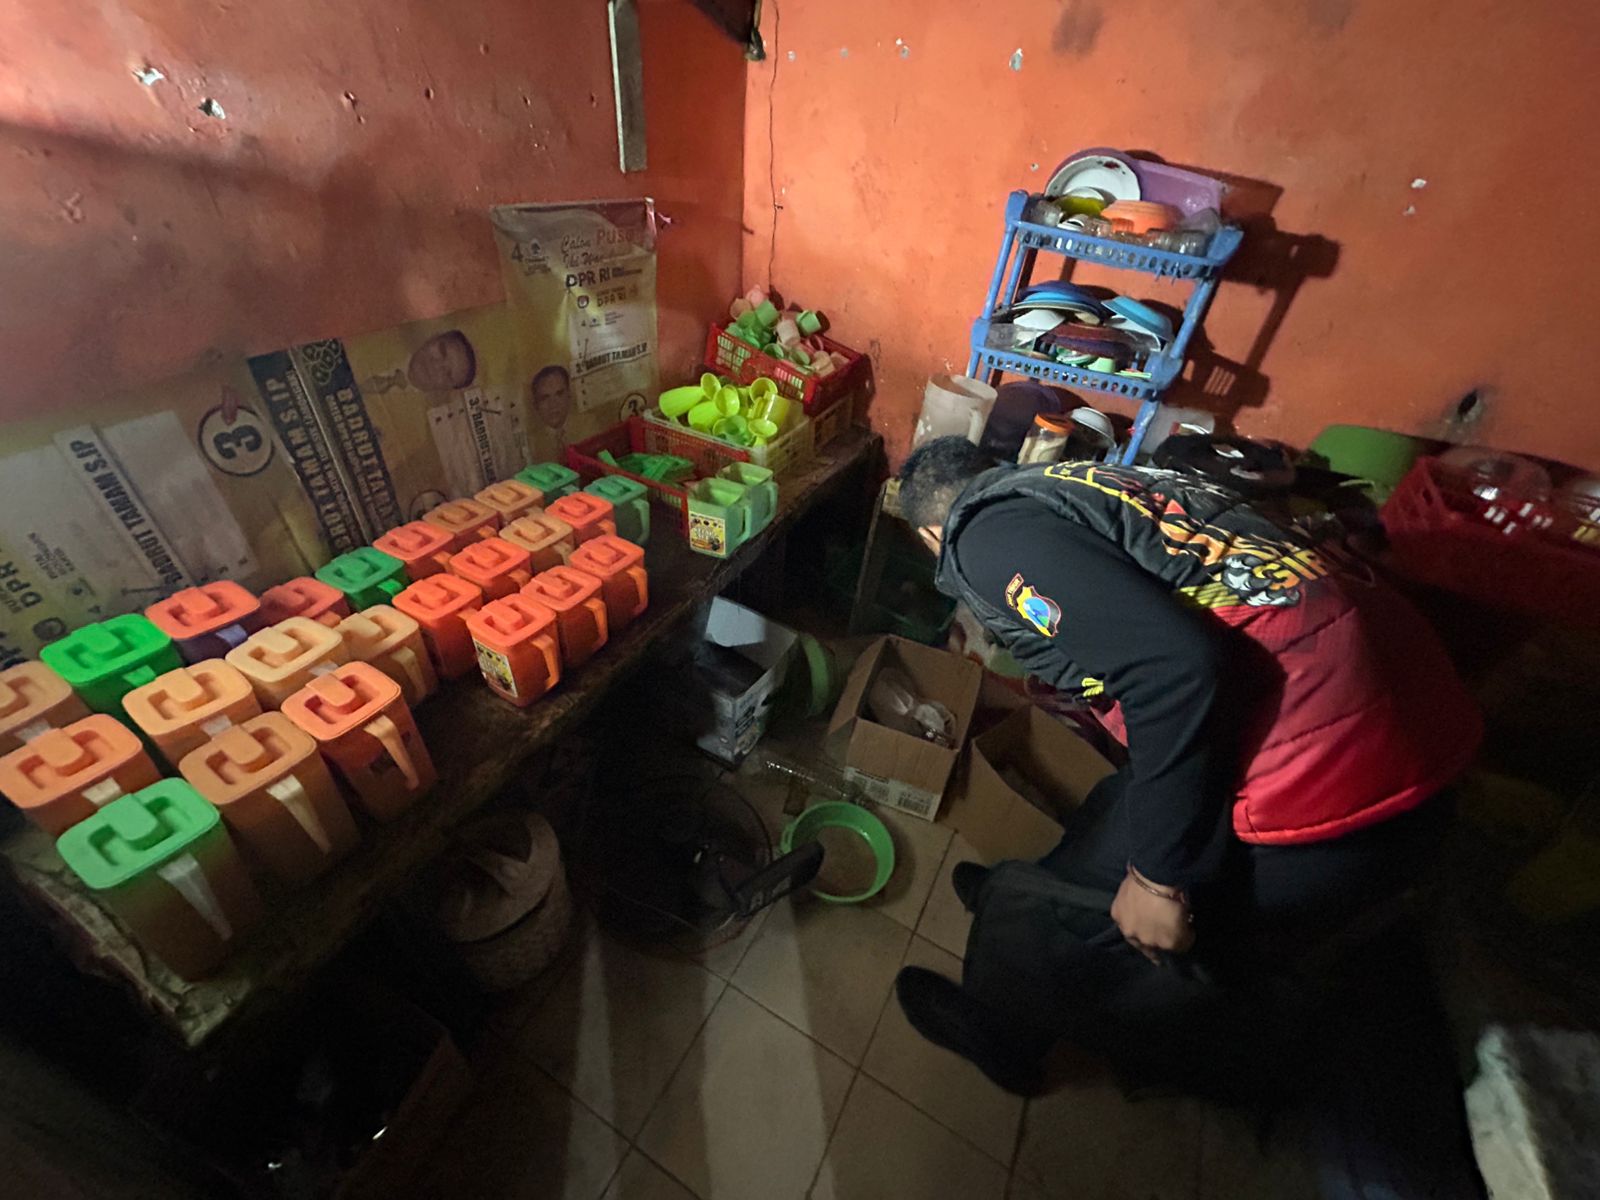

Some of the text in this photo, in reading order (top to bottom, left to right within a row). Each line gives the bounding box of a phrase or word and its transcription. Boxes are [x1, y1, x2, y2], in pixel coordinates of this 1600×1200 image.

[511, 243, 523, 262] 4
[565, 270, 596, 288] DPR
[600, 268, 611, 283] RI
[213, 425, 263, 460] 3
[336, 387, 379, 467] BADRUT
[472, 411, 491, 457] BADRUT
[287, 426, 331, 498] TAMAM
[94, 471, 146, 530] TAMAM
[132, 530, 184, 586] BADRUT
